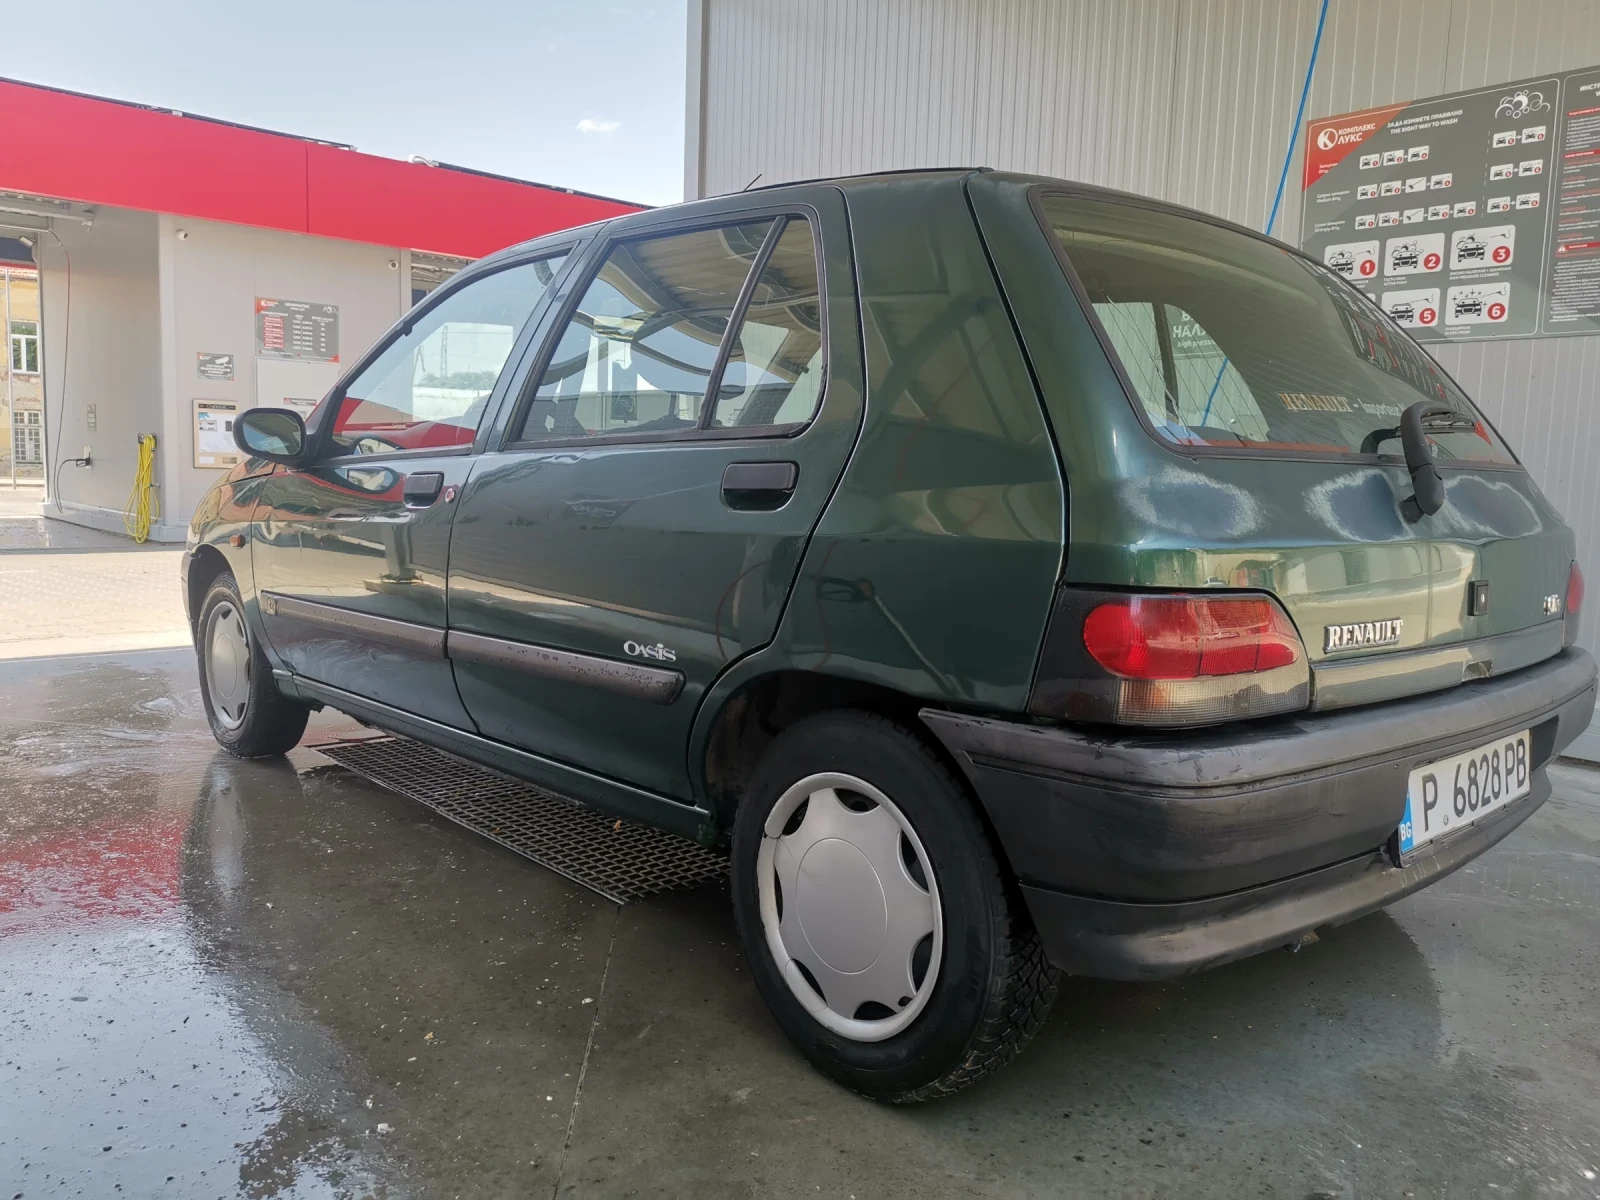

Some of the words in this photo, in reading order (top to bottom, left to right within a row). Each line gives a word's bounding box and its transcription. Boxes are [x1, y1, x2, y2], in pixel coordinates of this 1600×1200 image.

[1440, 118, 1458, 126] WASH
[1338, 123, 1376, 135] КОМПЛЕКС
[1338, 133, 1363, 145] ЛУКС
[1497, 249, 1506, 260] 3
[1427, 257, 1436, 267] 2
[1423, 311, 1432, 321] 5
[1492, 306, 1501, 316] 6
[1178, 340, 1192, 348] high
[1279, 392, 1353, 413] RENAULT
[1325, 620, 1404, 652] RENAULT
[1422, 770, 1438, 832] P
[1454, 748, 1501, 817] 6828
[1504, 738, 1526, 795] PB
[1400, 822, 1411, 841] BG
